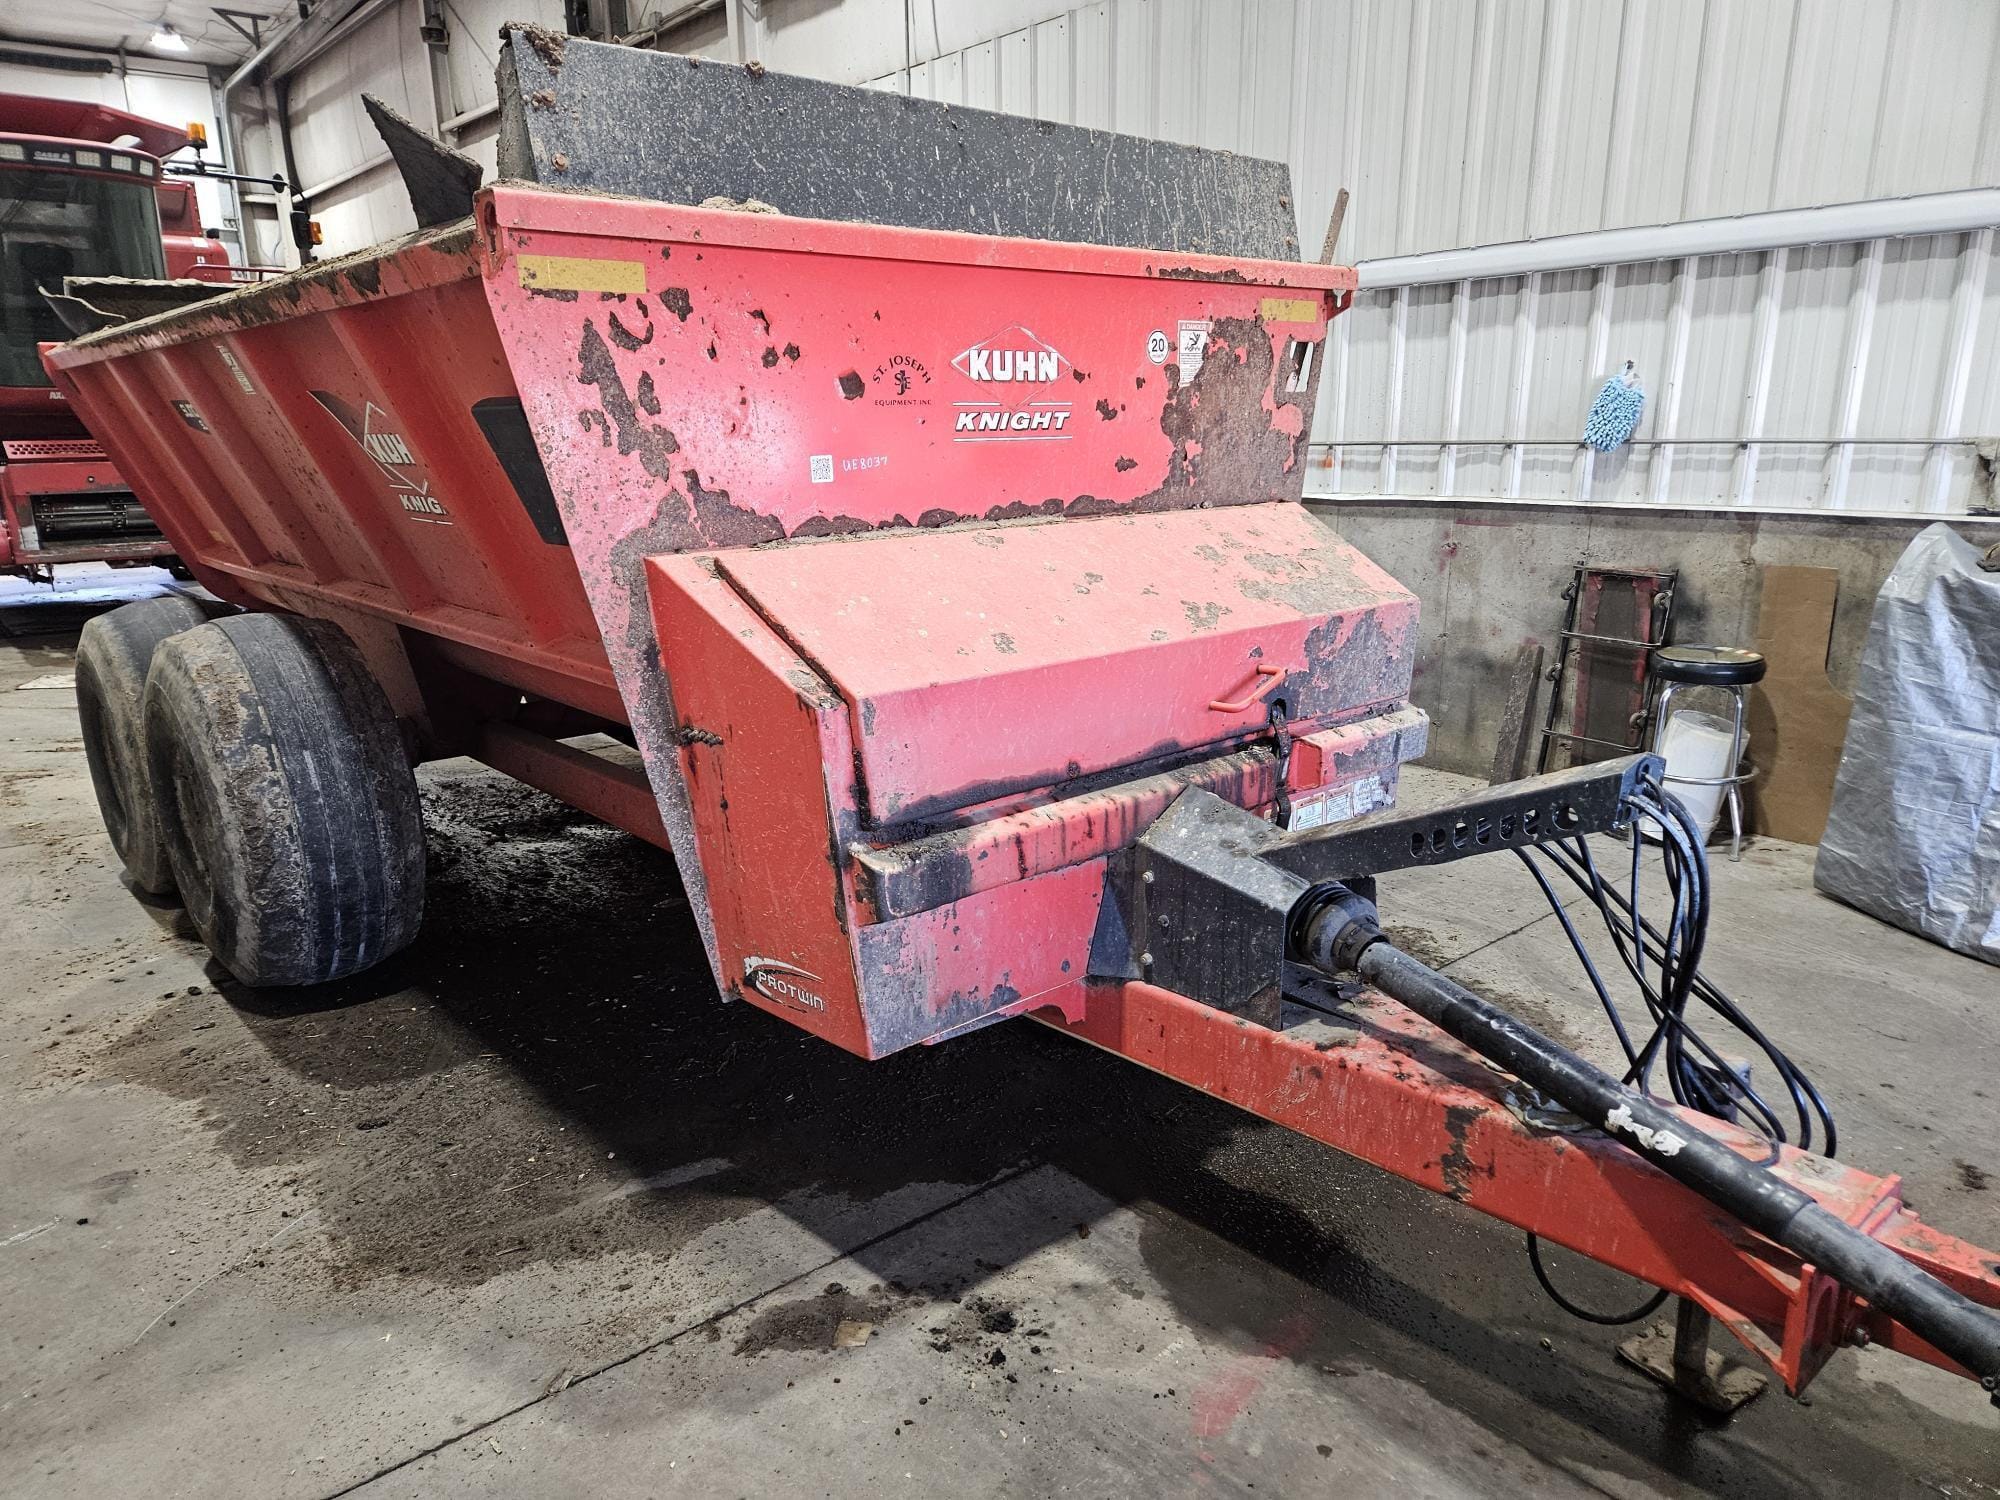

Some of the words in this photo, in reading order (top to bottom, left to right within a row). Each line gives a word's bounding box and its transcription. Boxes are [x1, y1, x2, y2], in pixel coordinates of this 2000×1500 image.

[1151, 338, 1165, 352] 20
[872, 364, 887, 384] ST.
[889, 355, 931, 383] JOSEPH
[968, 349, 1059, 382] KUHN
[955, 411, 1071, 431] KNIGHT
[366, 433, 417, 465] KUH
[842, 455, 888, 472] UE8037
[757, 971, 825, 1012] PROTWIN
